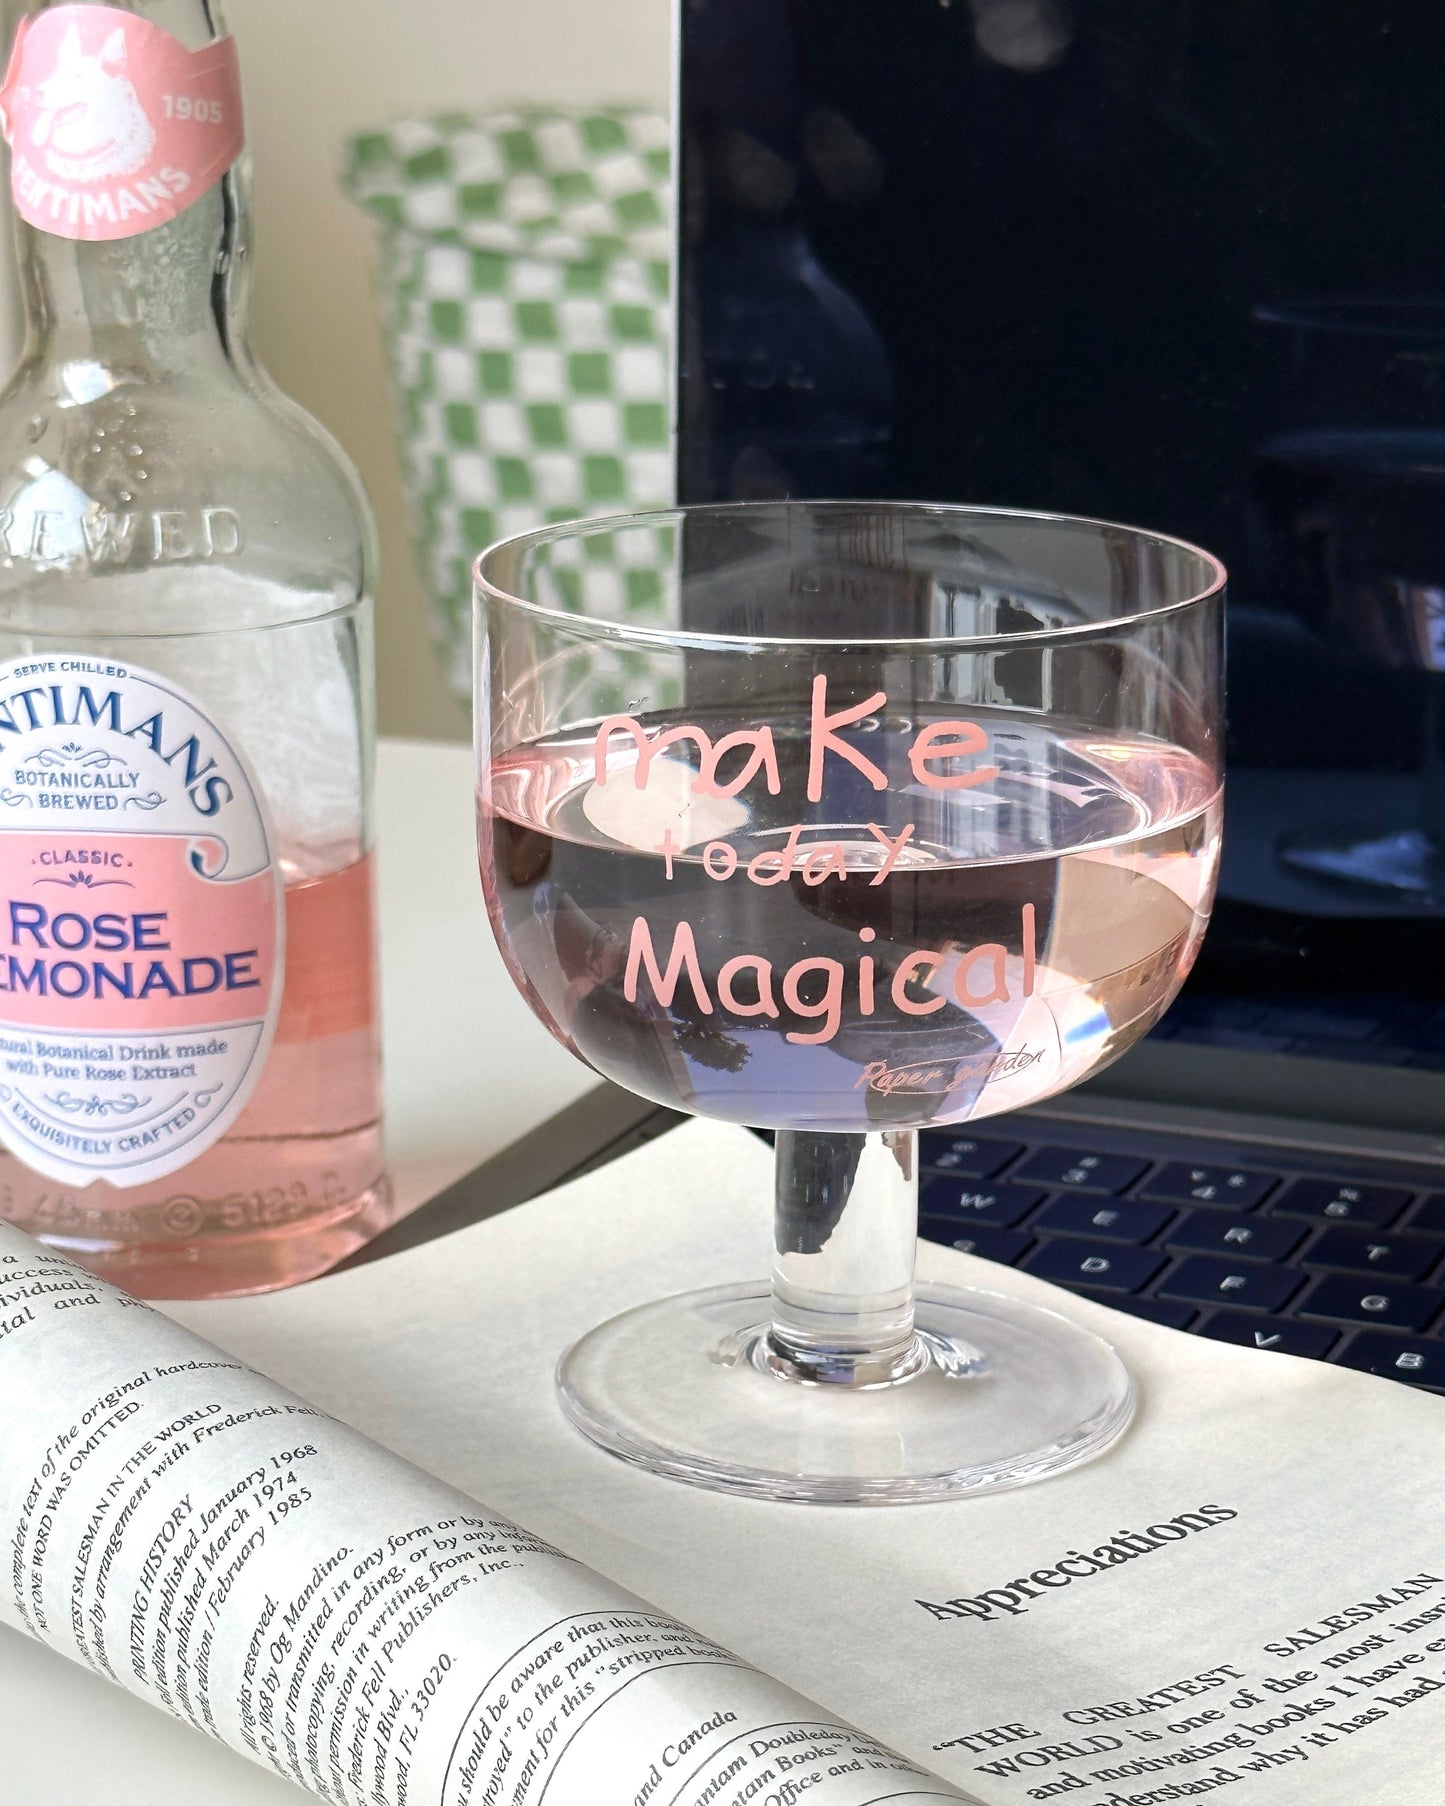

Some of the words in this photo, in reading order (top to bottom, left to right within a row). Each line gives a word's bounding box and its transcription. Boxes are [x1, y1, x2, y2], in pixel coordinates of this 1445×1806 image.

[162, 96, 223, 124] 1905
[14, 662, 56, 678] SERVE
[61, 661, 127, 678] CHILLED
[15, 769, 140, 789] BOTANICALLY
[39, 793, 119, 810] BREWED
[655, 823, 915, 886] today
[624, 903, 1036, 1044] Magical
[6, 1059, 38, 1076] with
[43, 1062, 80, 1079] Pure
[86, 1064, 126, 1080] Rose
[132, 1063, 196, 1080] Extract
[36, 1041, 114, 1061] Botanical
[119, 1042, 172, 1061] Drink
[177, 1039, 228, 1058] made
[12, 1102, 112, 1154] EXQUISITELY
[118, 1107, 196, 1152] CRAFTED
[3, 1255, 18, 1263] a
[54, 1293, 101, 1310] and
[1254, 1331, 1281, 1348] V
[1395, 1352, 1425, 1369] B
[70, 1402, 144, 1472] OMITTED.
[192, 1405, 282, 1444] Frederick
[11, 1517, 29, 1596] complete
[23, 1478, 42, 1517] text
[42, 1447, 57, 1478] of
[55, 1424, 80, 1456] the
[82, 1371, 152, 1425] original
[152, 1441, 191, 1478] with
[272, 1444, 318, 1470] 1968
[46, 1471, 71, 1511] WAS
[72, 1498, 110, 1598] SALESMAN
[107, 1475, 124, 1497] IN
[122, 1441, 157, 1476] THE
[154, 1404, 221, 1448] WORLD
[200, 1467, 266, 1534] January
[33, 1514, 52, 1567] WORD
[95, 1476, 151, 1600] arrangement
[139, 1493, 197, 1594] HISTORY
[386, 1526, 433, 1555] form
[438, 1519, 457, 1530] or
[460, 1516, 484, 1528] by
[32, 1570, 43, 1604] ONE
[158, 1528, 200, 1634] published
[175, 1567, 207, 1669] published
[202, 1507, 250, 1572] March
[253, 1470, 298, 1508] 1974
[353, 1551, 384, 1580] any
[915, 1503, 1238, 1621] Appreciations
[89, 1598, 107, 1619] by
[194, 1629, 213, 1692] edition
[208, 1526, 266, 1618] February
[268, 1487, 312, 1526] 1985
[282, 1547, 354, 1633] Mandino.
[334, 1581, 352, 1602] in
[130, 1589, 150, 1686] PRINTING
[152, 1628, 168, 1686] edition
[243, 1594, 279, 1686] reserved.
[270, 1631, 292, 1665] Og
[285, 1600, 334, 1714] transmitted
[305, 1661, 335, 1784] photocopying,
[330, 1566, 407, 1656] recording,
[410, 1548, 429, 1564] or
[434, 1533, 458, 1550] by
[463, 1529, 496, 1541] any
[330, 1667, 358, 1774] permission
[352, 1641, 369, 1665] in
[367, 1575, 430, 1639] writing
[429, 1552, 475, 1582] from
[478, 1544, 507, 1556] the
[1062, 1664, 1246, 1724] GREATEST
[1263, 1573, 1444, 1657] SALESMAN
[261, 1666, 281, 1693] by
[348, 1706, 370, 1793] Frederick
[361, 1660, 387, 1708] Fell
[381, 1575, 478, 1664] Publishers,
[399, 1724, 418, 1757] FL
[410, 1653, 457, 1722] 33020.
[459, 1717, 493, 1794] should
[486, 1694, 509, 1722] be
[511, 1641, 564, 1693] aware
[567, 1621, 607, 1643] that
[609, 1617, 643, 1628] this
[517, 1706, 533, 1730] to
[534, 1675, 563, 1706] the
[565, 1632, 658, 1680] publisher,
[661, 1634, 694, 1643] and
[974, 1735, 1124, 1777] WORLD
[1126, 1729, 1163, 1742] is
[1167, 1709, 1226, 1735] one
[1230, 1688, 1266, 1708] of
[1262, 1670, 1318, 1693] the
[1321, 1634, 1395, 1669] most
[237, 1684, 256, 1734] rights
[259, 1690, 274, 1737] 1968
[285, 1711, 295, 1736] or
[536, 1716, 558, 1760] for
[560, 1681, 596, 1718] this
[1026, 1771, 1093, 1800] and
[1089, 1732, 1256, 1782] motivating
[1235, 1698, 1336, 1736] books
[1326, 1685, 1359, 1698] I
[1343, 1653, 1426, 1687] have
[1238, 1745, 1309, 1772] why
[1301, 1732, 1338, 1747] it
[1322, 1708, 1389, 1734] has
[1373, 1676, 1445, 1708] had
[662, 1711, 738, 1767] Canada
[748, 1729, 850, 1758] Doubleday
[828, 1759, 864, 1776] and
[866, 1759, 887, 1769] in
